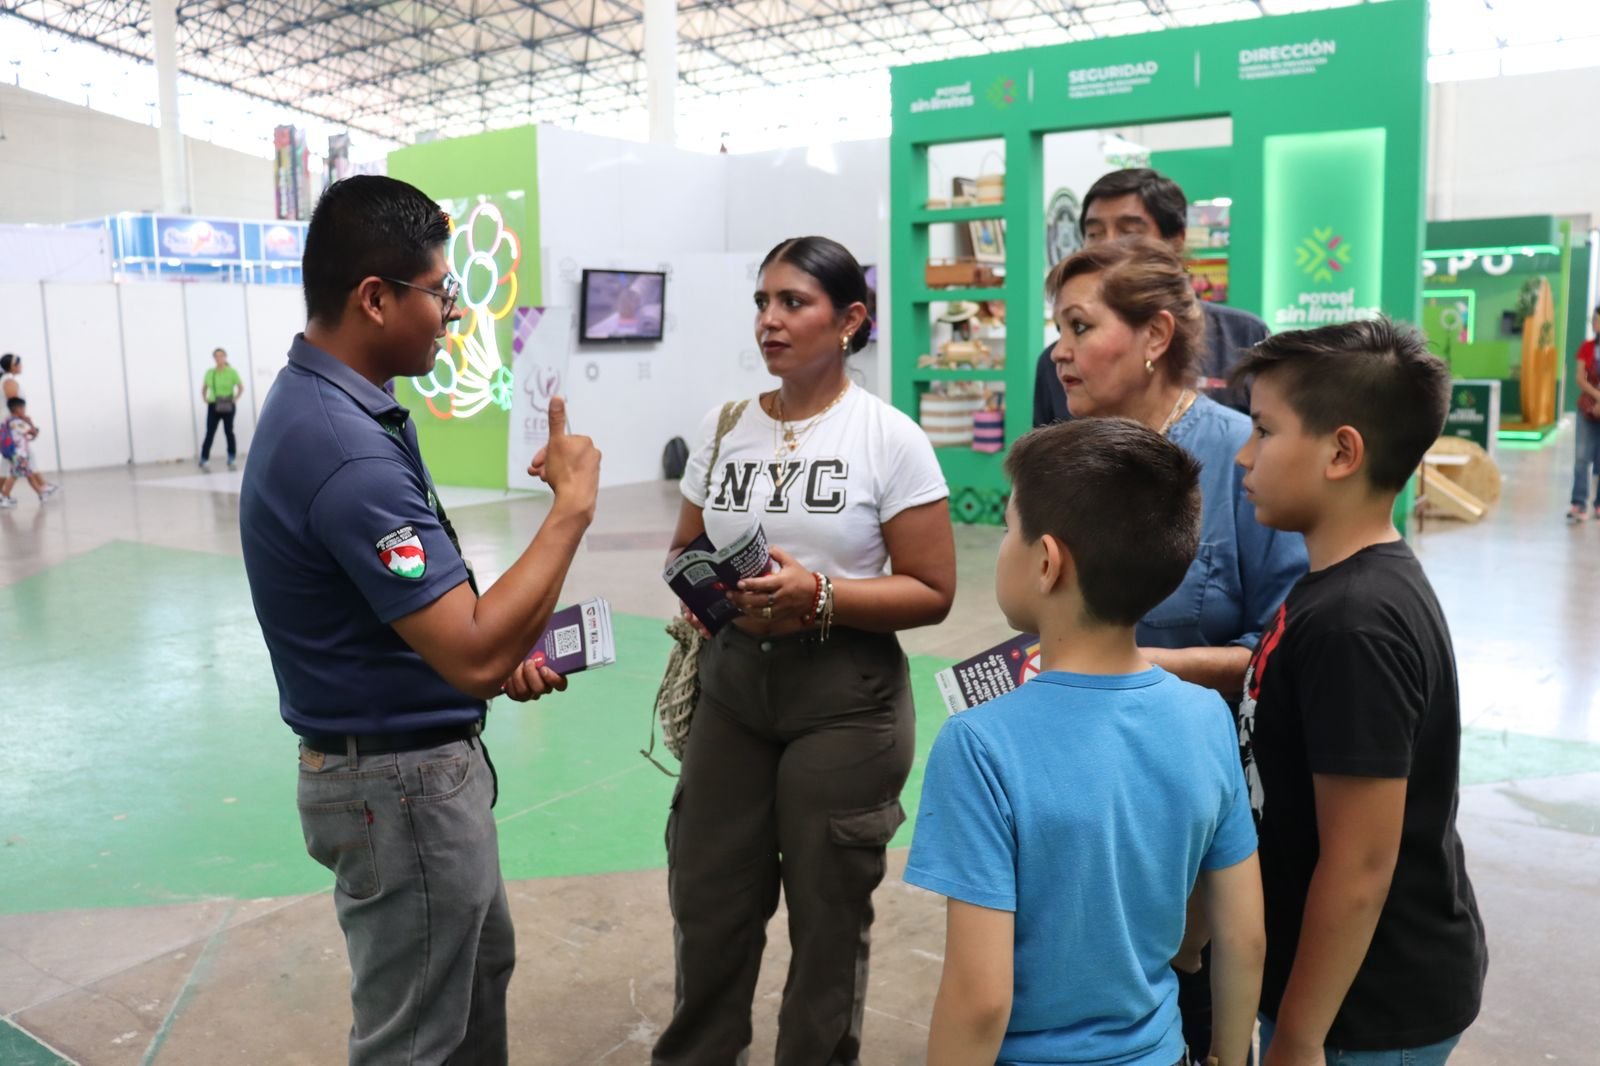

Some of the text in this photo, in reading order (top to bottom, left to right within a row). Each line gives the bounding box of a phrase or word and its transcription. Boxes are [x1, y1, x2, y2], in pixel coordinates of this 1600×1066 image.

[1239, 38, 1336, 65] DIRECCIÓN
[1068, 60, 1158, 84] SEGURIDAD
[1275, 304, 1306, 323] sin
[711, 457, 848, 513] NYC
[974, 663, 985, 681] una
[988, 655, 997, 667] de
[959, 669, 973, 695] hacer
[967, 667, 985, 700] caso de
